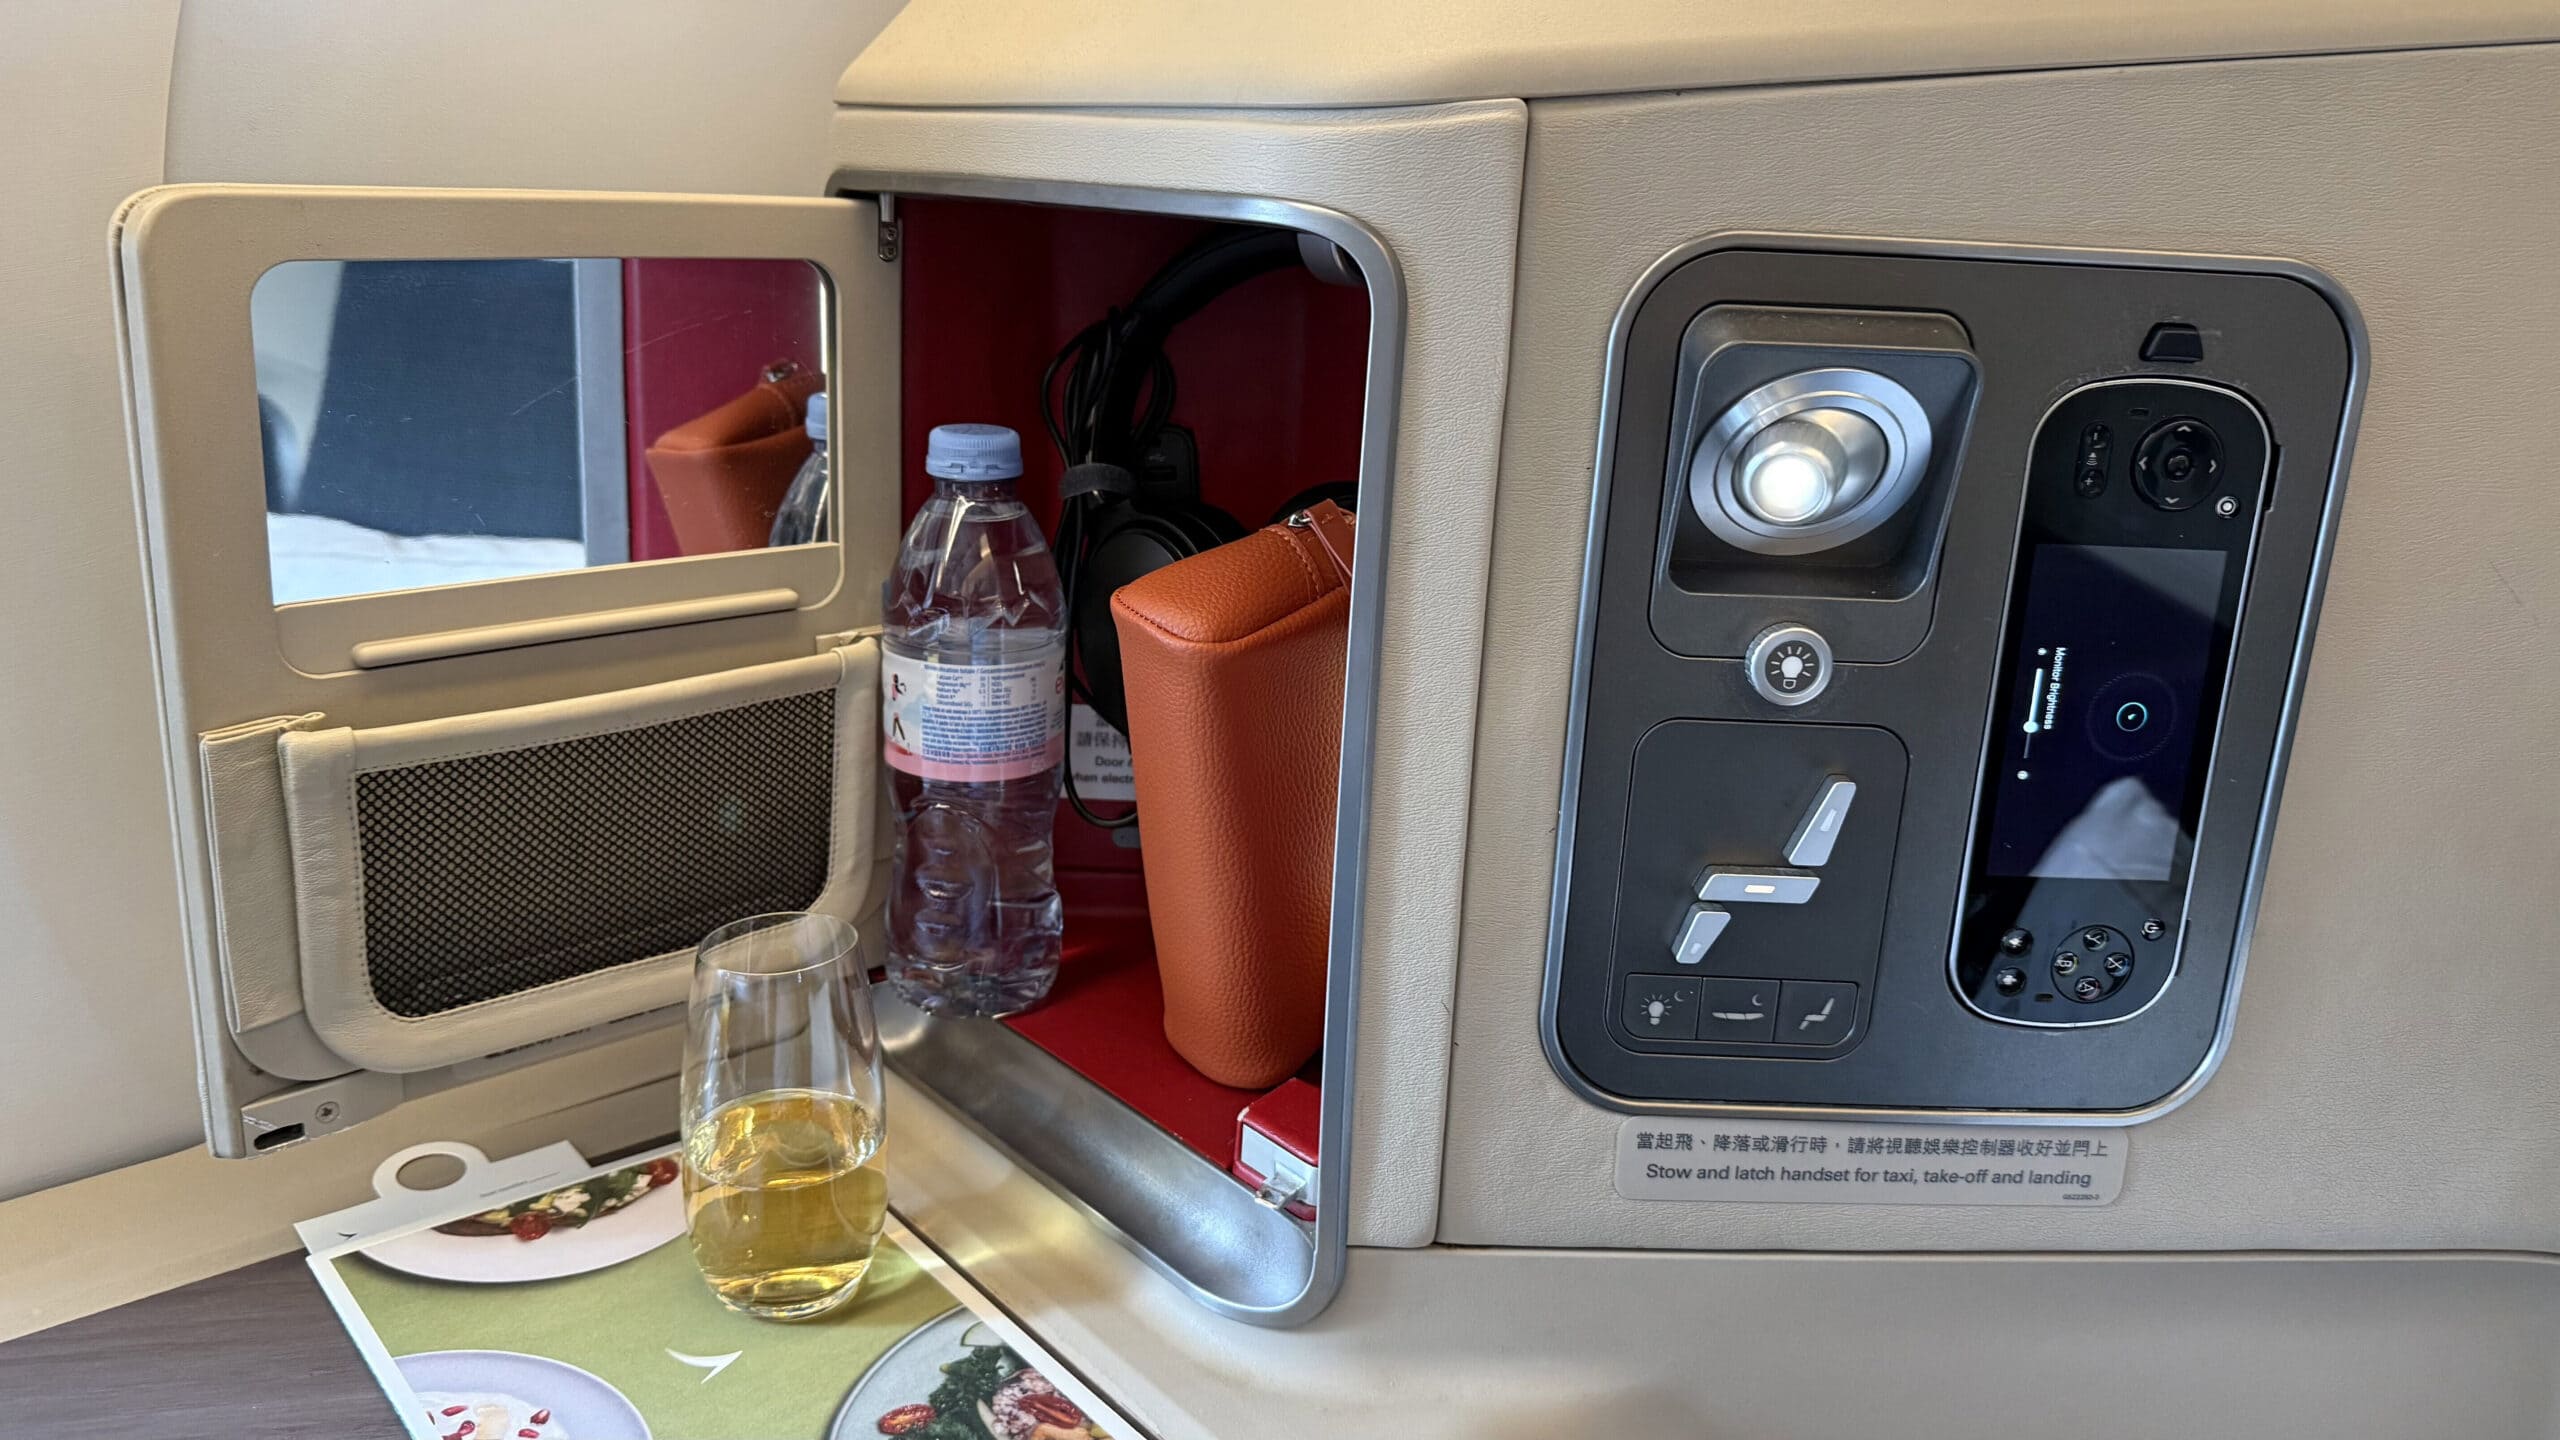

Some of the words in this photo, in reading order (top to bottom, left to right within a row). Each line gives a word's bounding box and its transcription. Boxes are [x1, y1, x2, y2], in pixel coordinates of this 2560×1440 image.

[2052, 647, 2066, 681] Monitor
[2043, 682, 2060, 730] Brightness
[1095, 755, 1124, 767] Door
[1646, 1163, 1692, 1179] Stow
[1696, 1165, 1730, 1180] and
[1735, 1165, 1775, 1181] latch
[1780, 1166, 1850, 1182] handset
[1854, 1167, 1879, 1182] for
[1883, 1168, 1918, 1185] taxi,
[1923, 1169, 1988, 1184] take-off
[1992, 1169, 2024, 1185] and
[2028, 1170, 2091, 1188] landing
